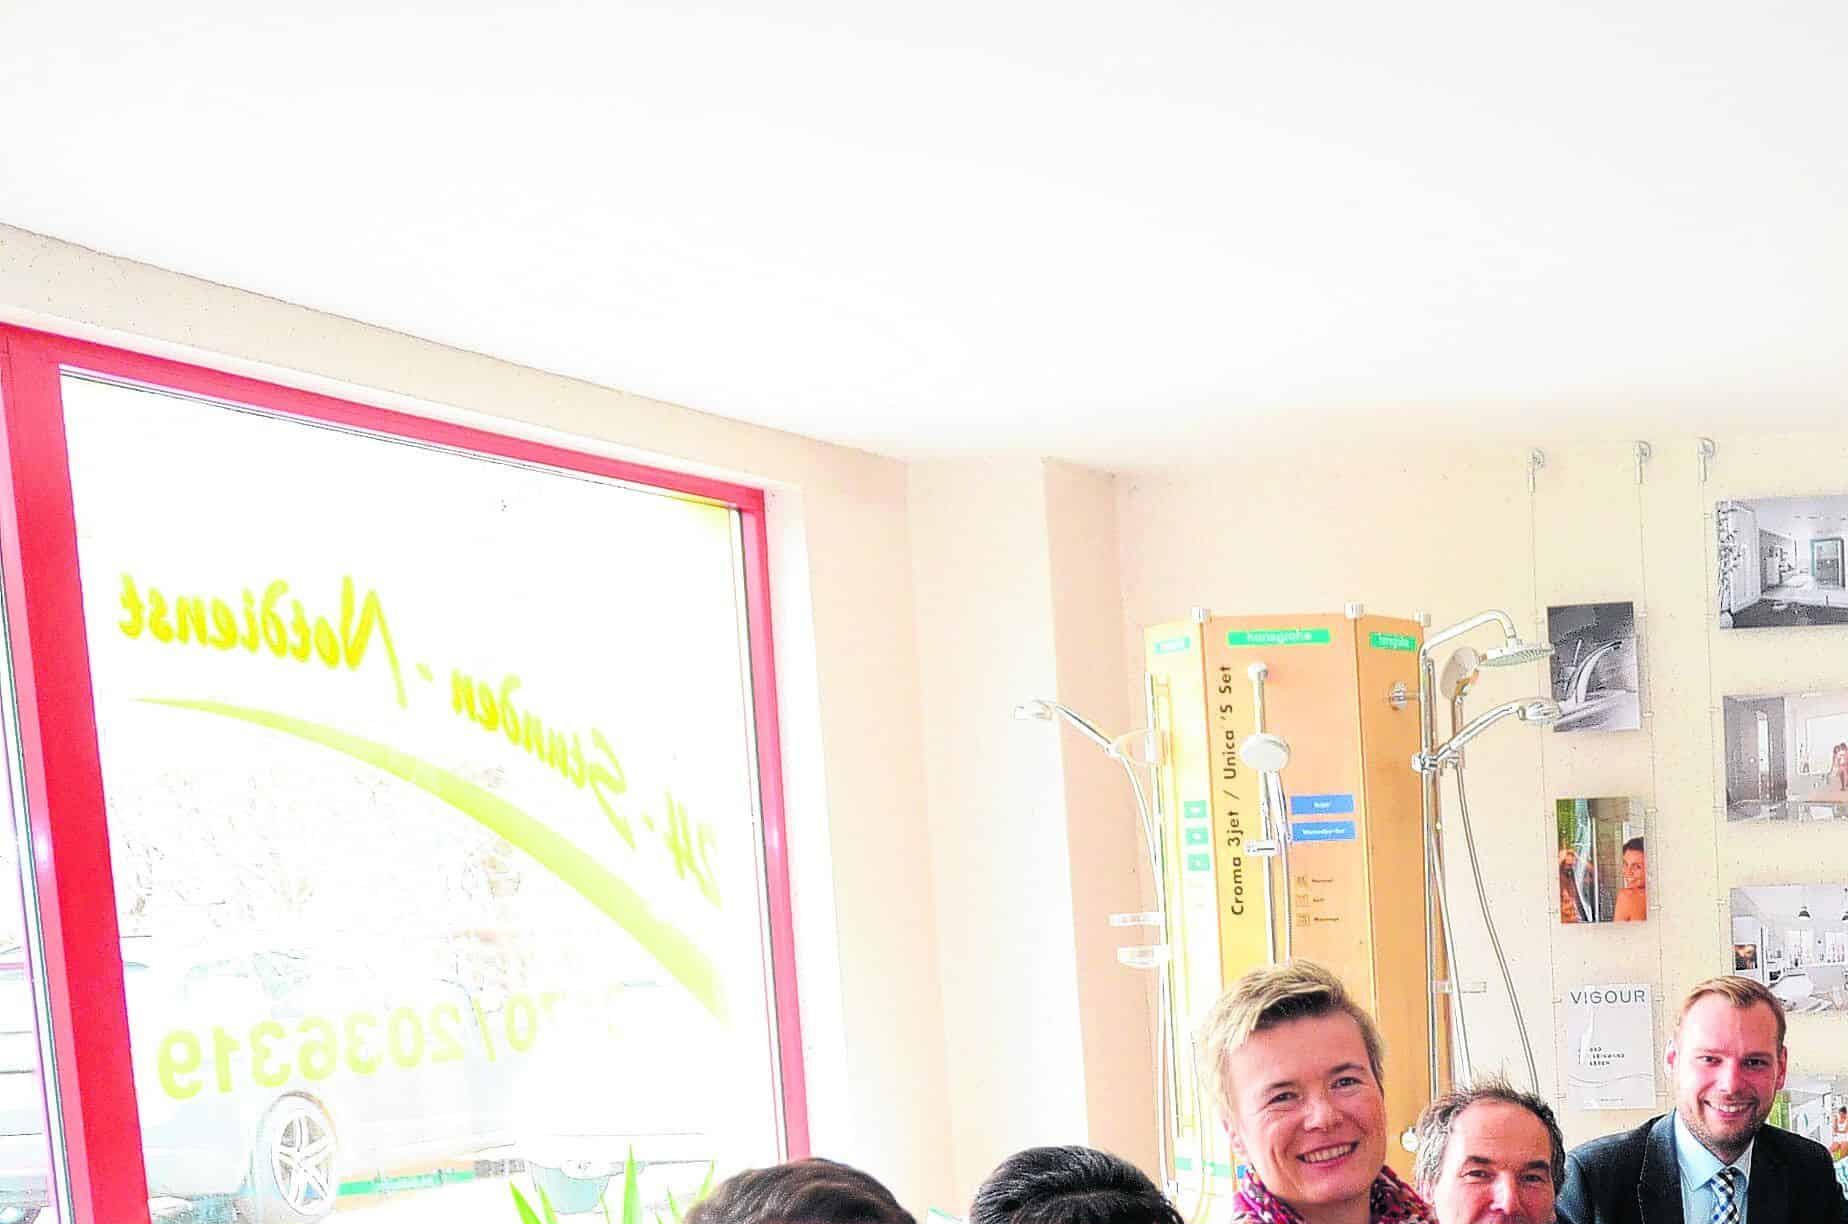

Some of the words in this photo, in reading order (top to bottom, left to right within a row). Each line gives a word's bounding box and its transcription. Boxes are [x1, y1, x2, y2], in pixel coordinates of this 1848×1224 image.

[1219, 665, 1232, 694] Set
[1222, 730, 1237, 780] Unica
[1227, 811, 1244, 846] 3jet
[1231, 857, 1244, 916] Croma
[1570, 990, 1645, 1004] VIGOUR
